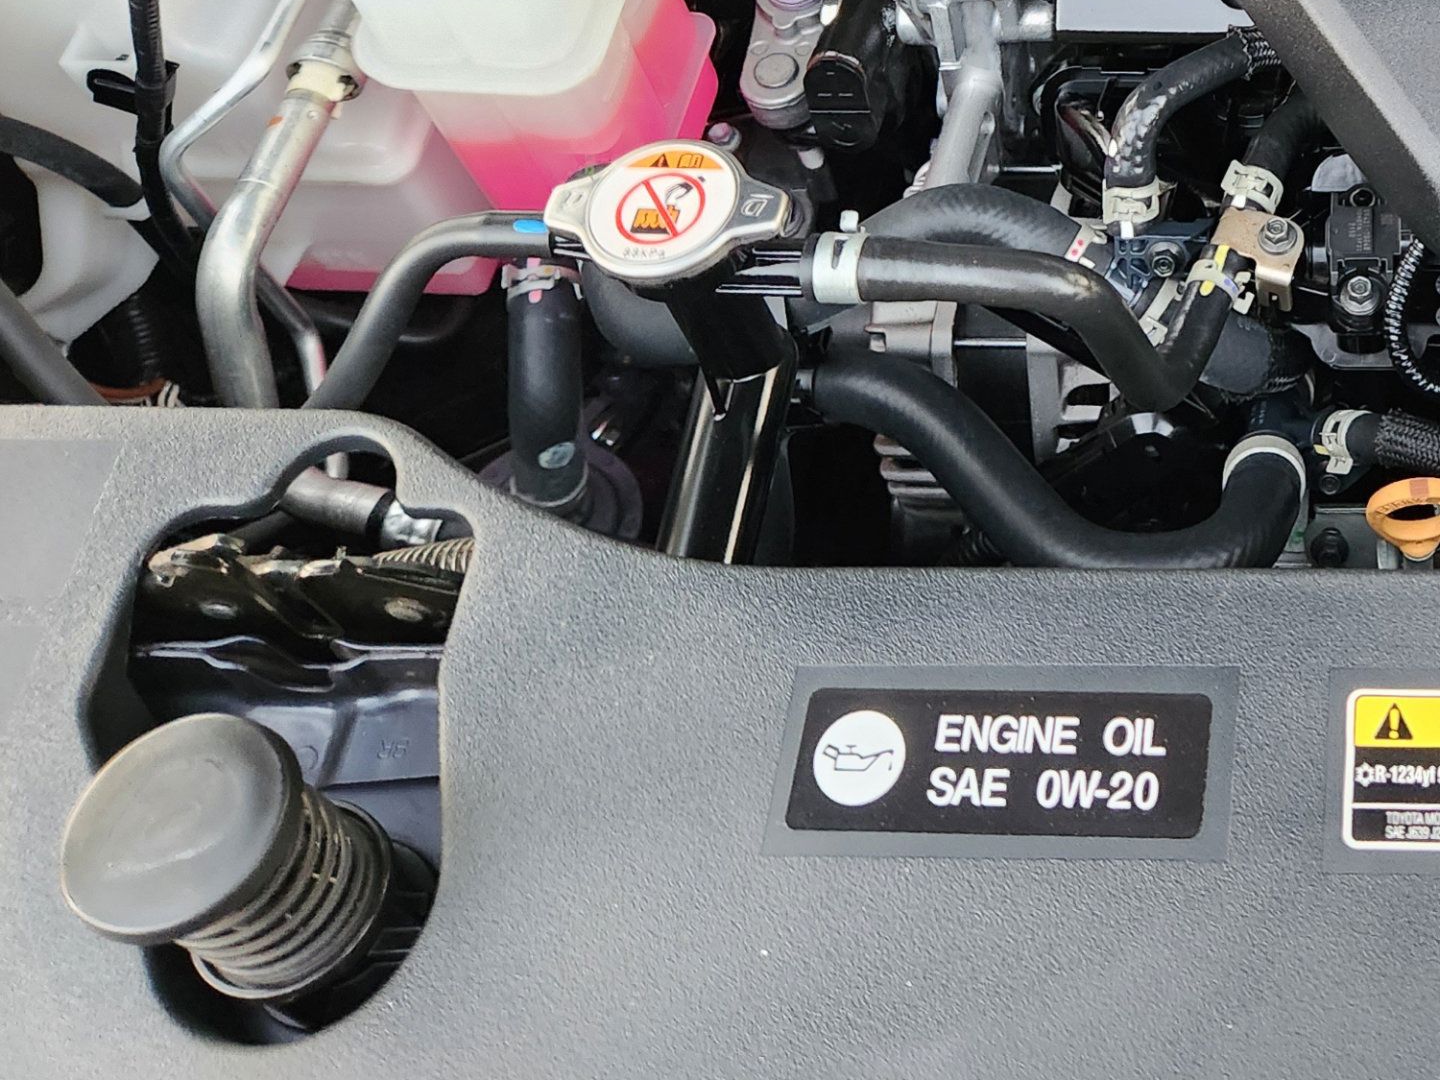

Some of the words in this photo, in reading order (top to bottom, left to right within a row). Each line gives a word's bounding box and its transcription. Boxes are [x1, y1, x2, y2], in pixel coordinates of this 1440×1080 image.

[933, 714, 1080, 755] ENGINE
[1101, 716, 1167, 757] OIL
[1374, 765, 1436, 788] R-1234yf
[925, 766, 1010, 807] SAE
[1036, 770, 1160, 811] 0W-20
[1385, 811, 1424, 825] TOYOTA
[1385, 825, 1406, 839] SAE
